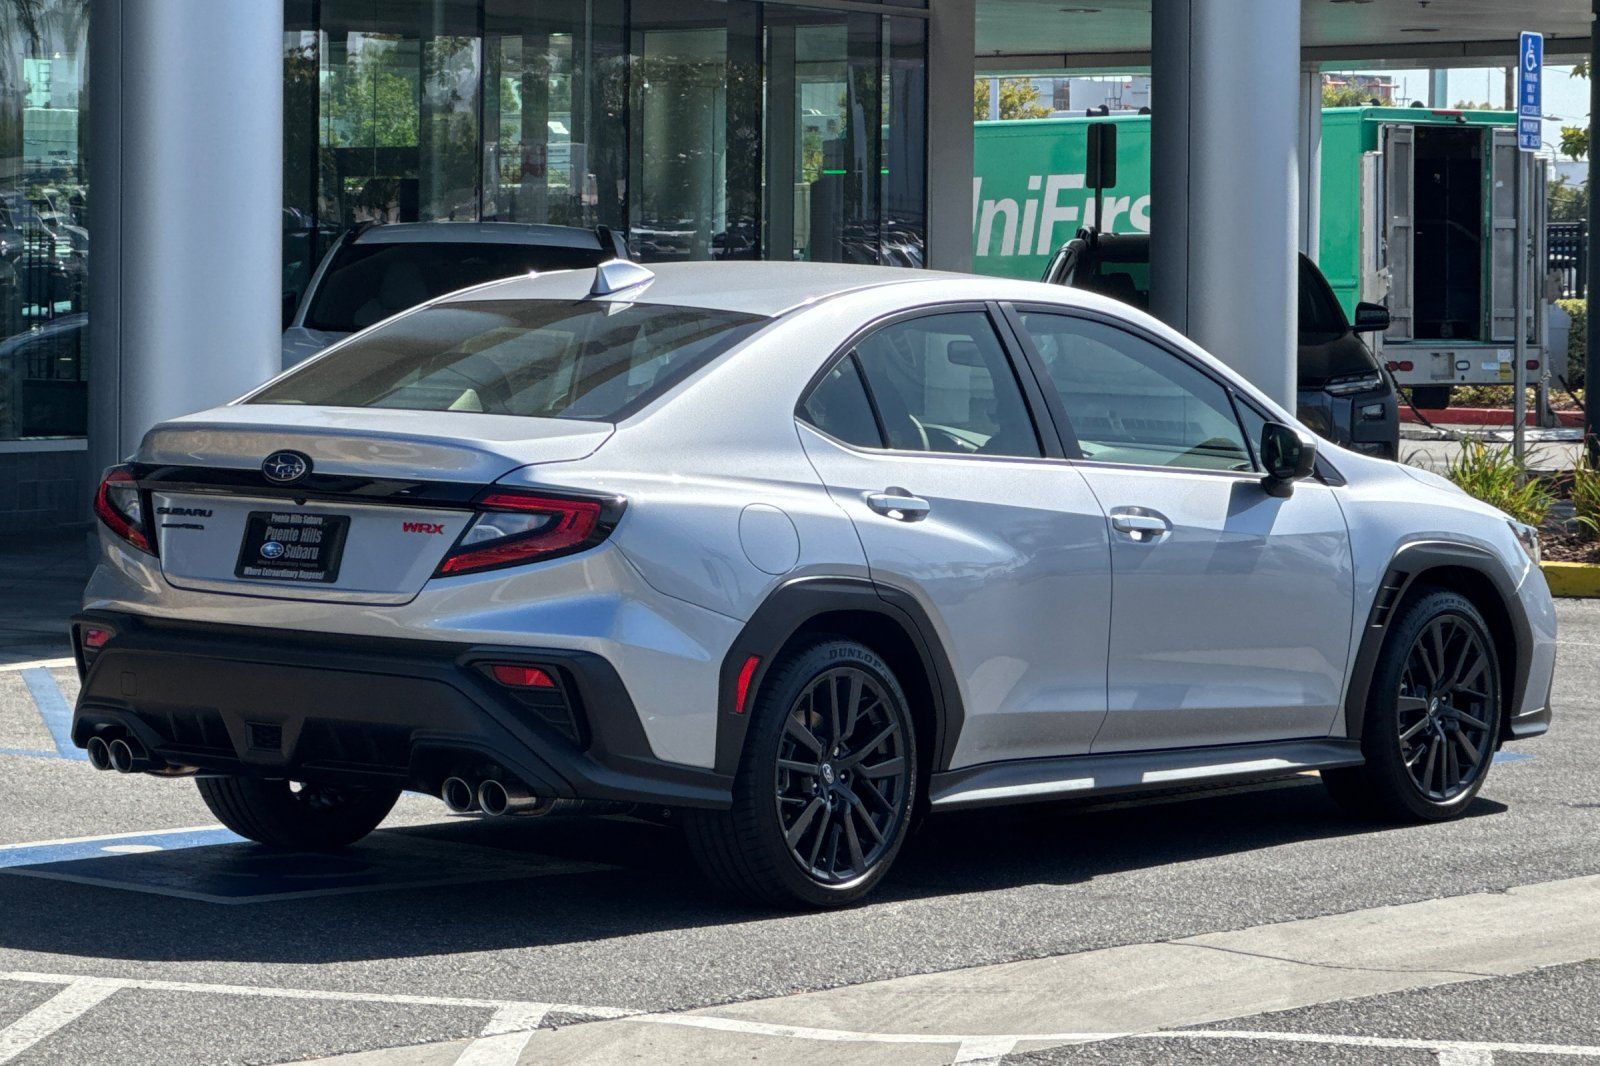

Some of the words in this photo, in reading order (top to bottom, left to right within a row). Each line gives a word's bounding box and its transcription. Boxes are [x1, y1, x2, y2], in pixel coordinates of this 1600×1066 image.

[156, 507, 213, 517] SUBARU
[264, 526, 299, 541] Puente
[300, 527, 322, 543] Hills
[403, 522, 445, 534] WRX
[284, 543, 319, 560] Subaru
[829, 647, 882, 669] DUNLOP
